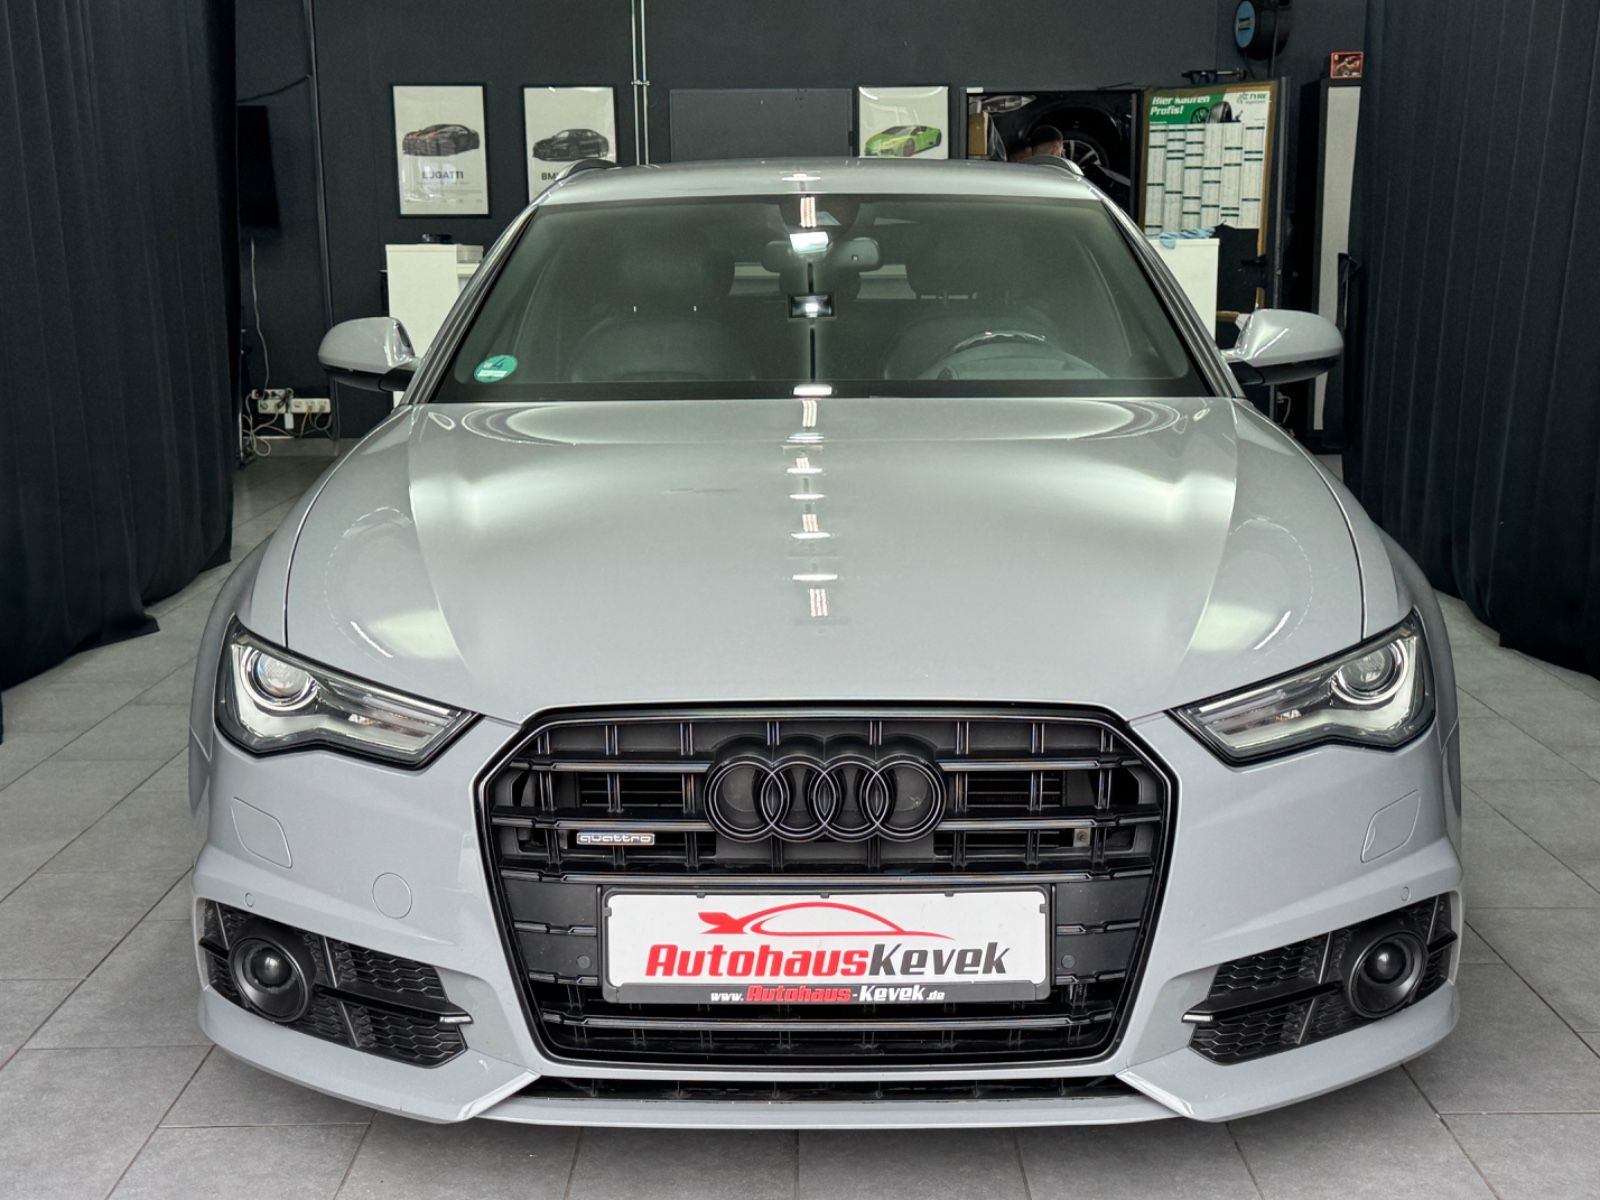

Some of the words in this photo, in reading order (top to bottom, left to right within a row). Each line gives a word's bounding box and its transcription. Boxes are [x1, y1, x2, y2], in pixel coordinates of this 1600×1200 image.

[1152, 96, 1173, 105] Hier
[1150, 105, 1184, 115] Profis!
[541, 172, 558, 180] BM
[580, 835, 651, 843] quattro
[645, 943, 1010, 977] AutohausKevek
